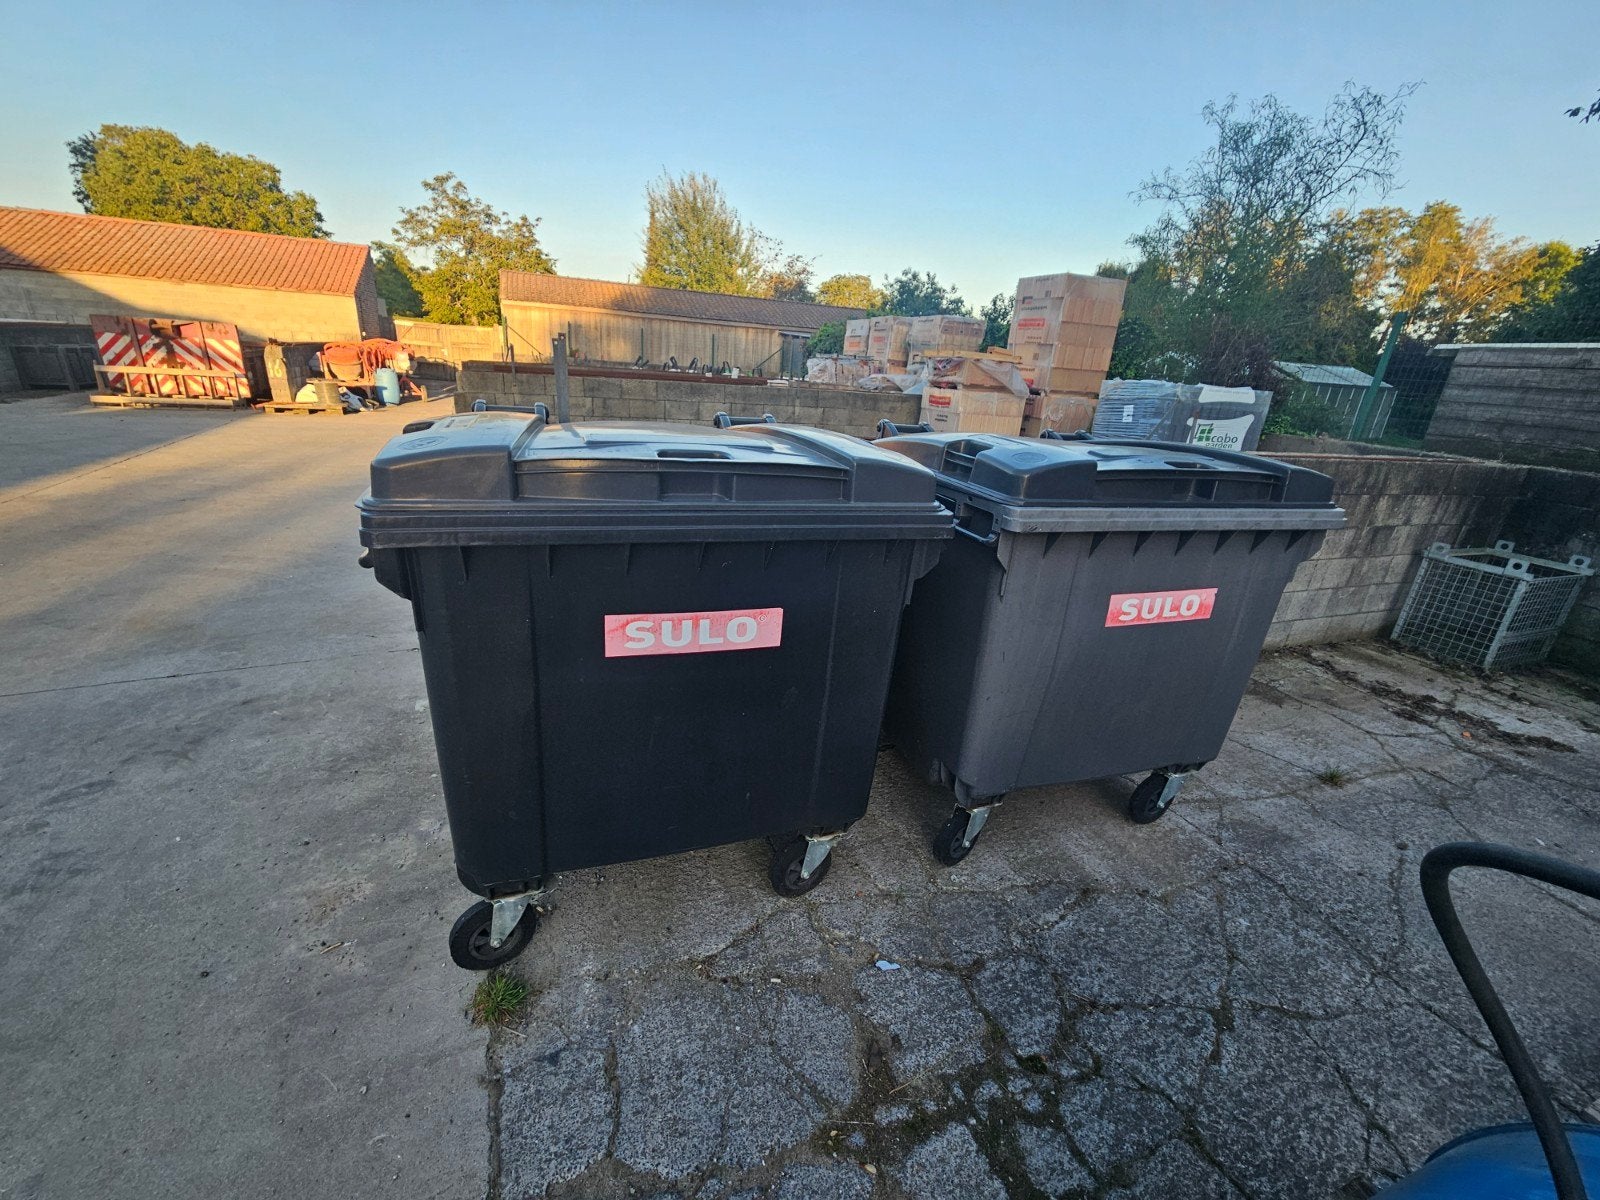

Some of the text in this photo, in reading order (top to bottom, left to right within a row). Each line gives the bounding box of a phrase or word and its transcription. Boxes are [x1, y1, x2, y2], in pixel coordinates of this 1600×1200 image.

[1211, 432, 1239, 444] cobo
[1119, 594, 1201, 621] SULO
[623, 615, 758, 649] SULO
